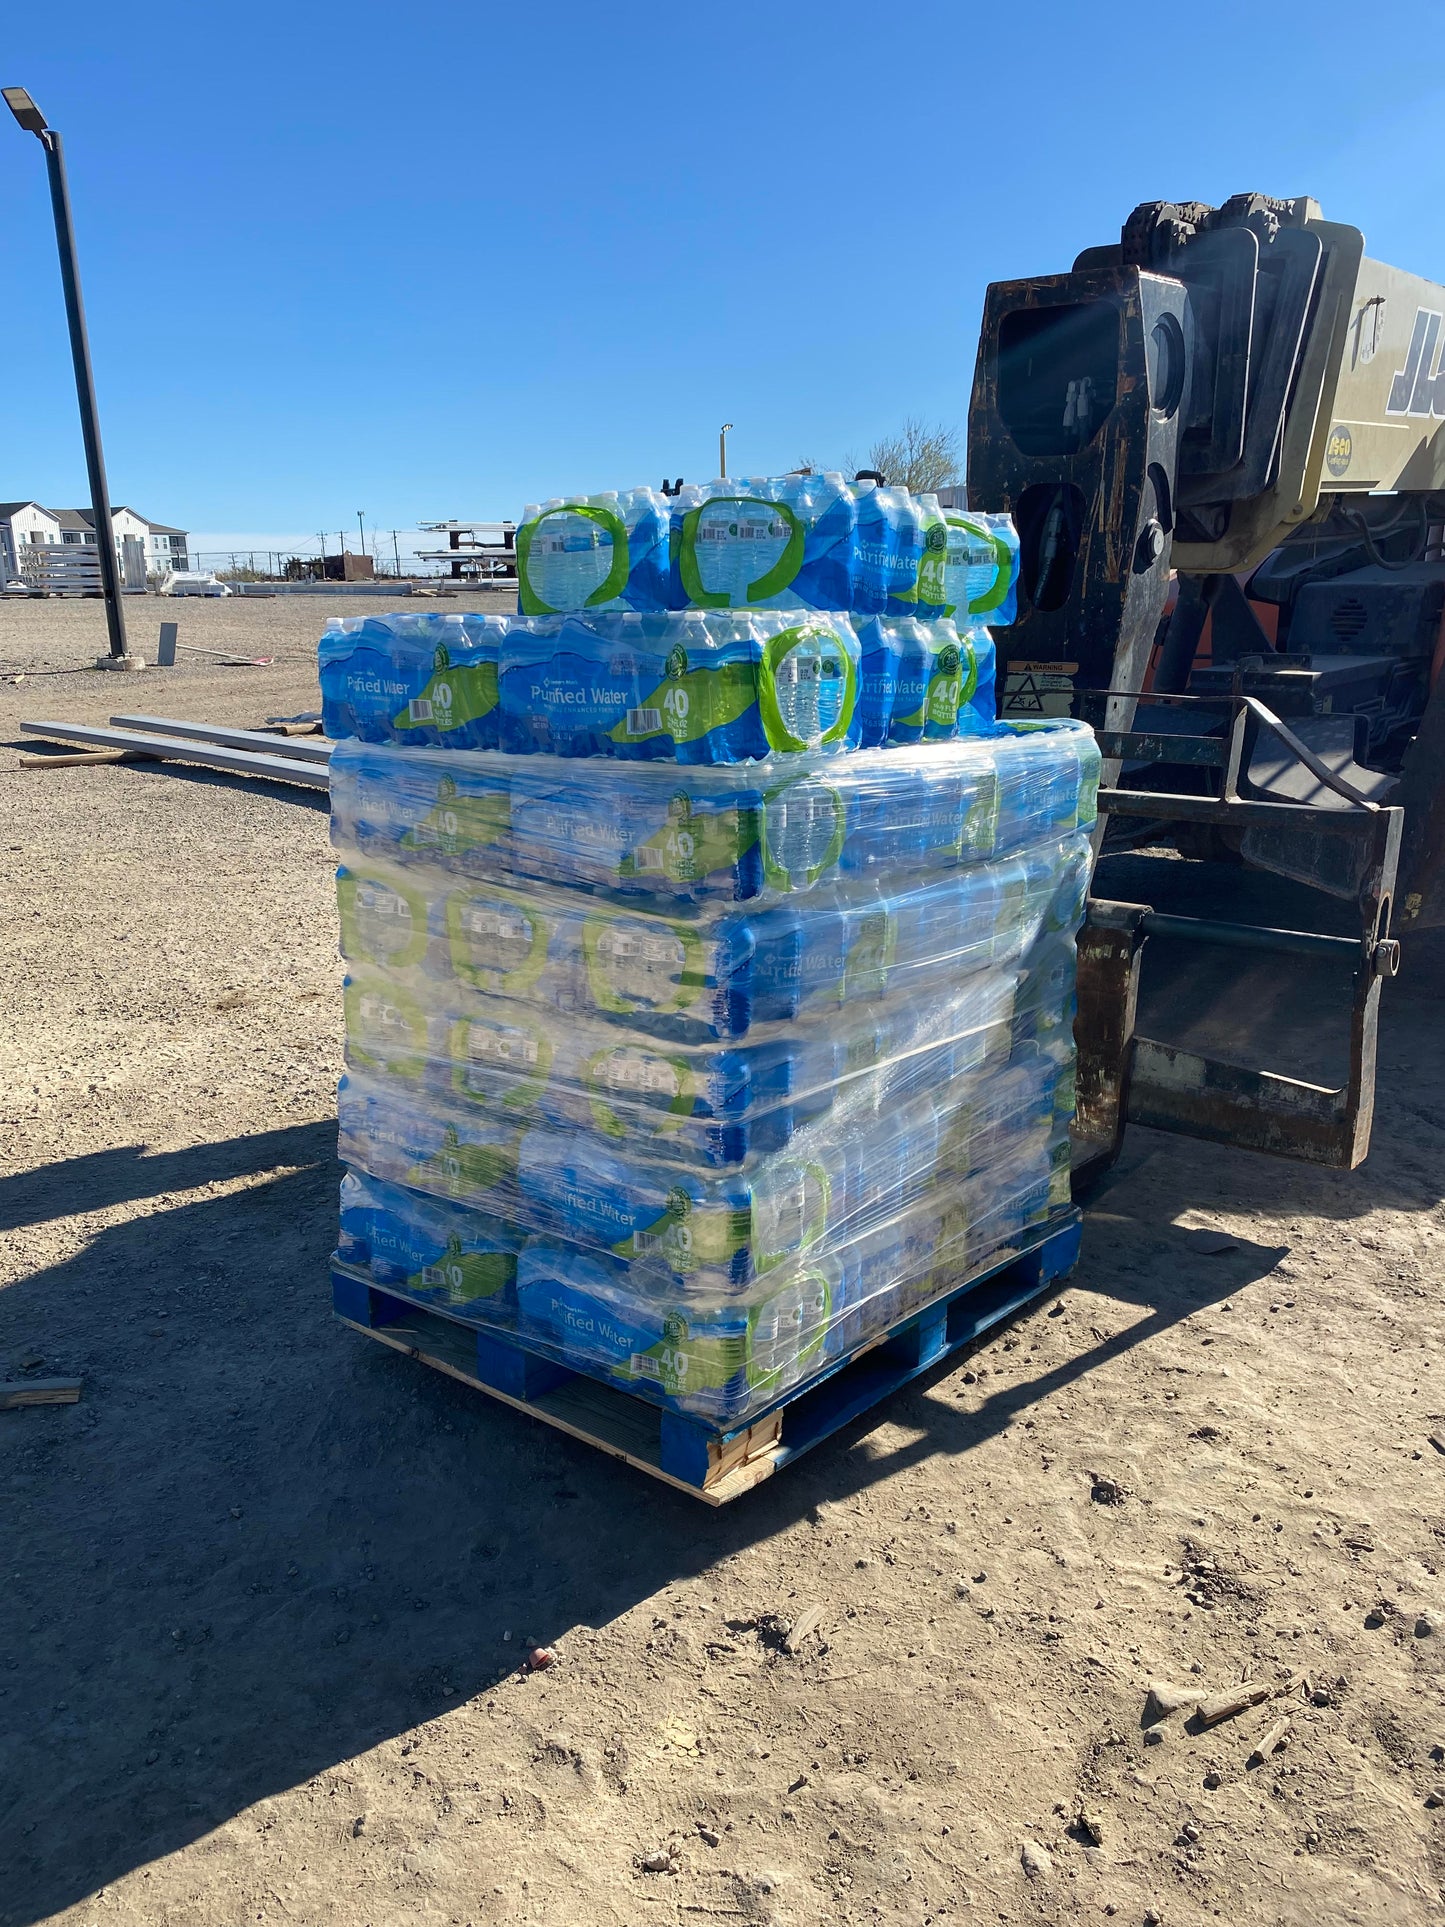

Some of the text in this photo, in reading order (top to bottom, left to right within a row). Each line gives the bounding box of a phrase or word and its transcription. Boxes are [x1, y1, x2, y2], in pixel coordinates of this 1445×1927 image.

[1385, 305, 1445, 419] JL
[853, 545, 889, 568] Purifi
[921, 559, 946, 586] 40
[1033, 663, 1063, 671] WARNING
[432, 682, 453, 710] 40
[591, 687, 629, 705] Water
[663, 688, 690, 719] 40
[932, 680, 959, 704] 40
[666, 831, 695, 859] 40
[663, 1223, 693, 1251] 40
[660, 1348, 689, 1377] 40
